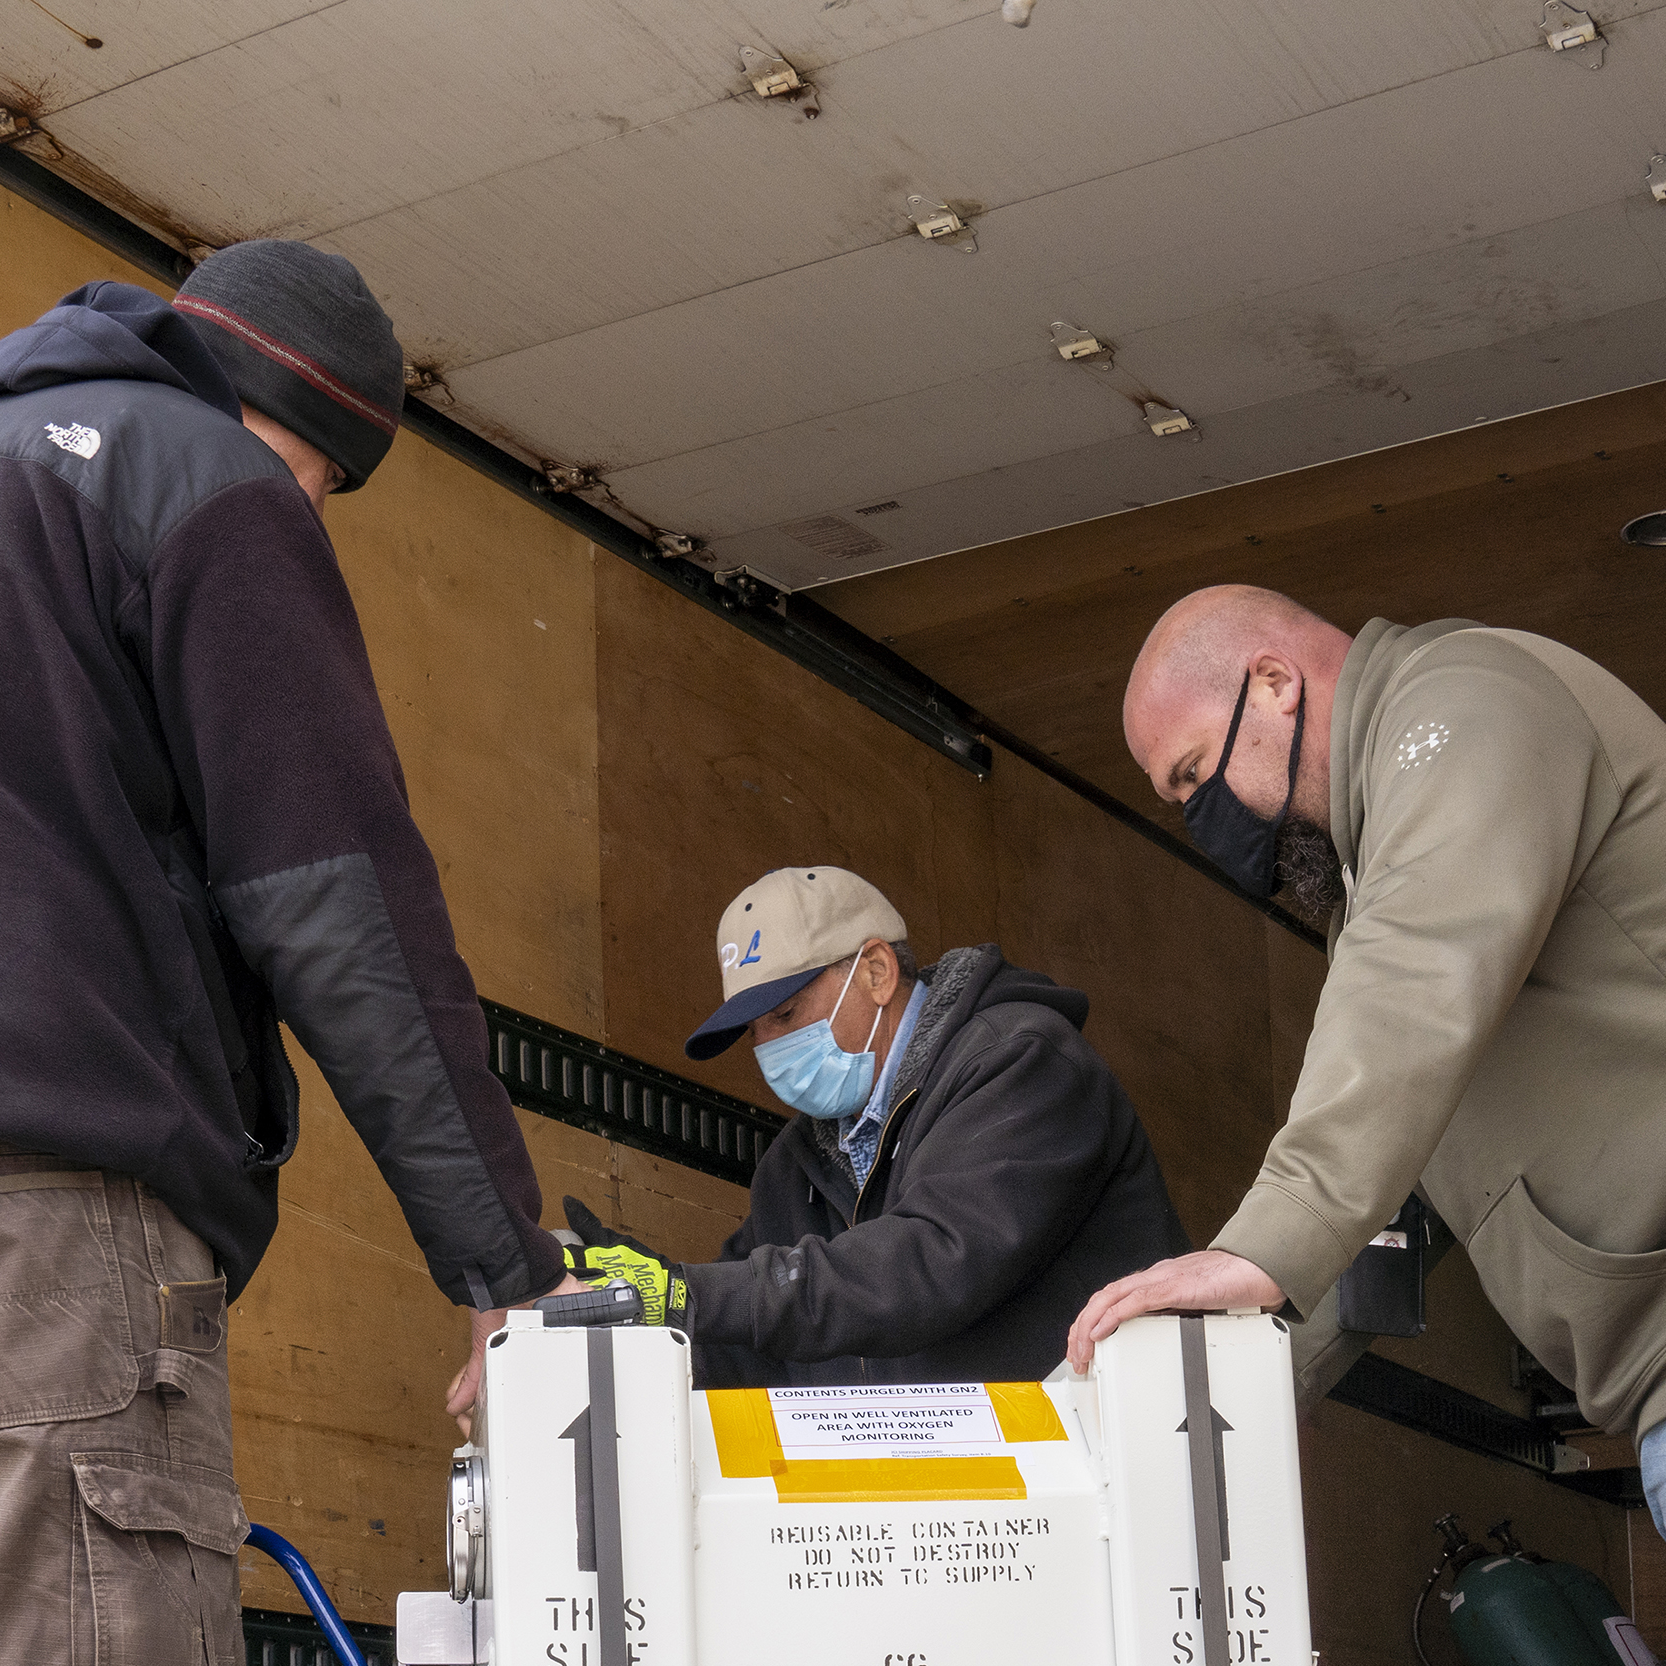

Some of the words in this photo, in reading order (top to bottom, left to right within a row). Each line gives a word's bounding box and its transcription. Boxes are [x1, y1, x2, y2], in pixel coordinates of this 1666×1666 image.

[44, 422, 84, 444] NORTH
[69, 422, 92, 436] THE
[47, 433, 81, 452] FACE
[630, 1263, 665, 1326] Mechan
[774, 1388, 847, 1398] CONTENTS
[850, 1387, 906, 1397] PURGED
[910, 1386, 946, 1395] WITH
[949, 1385, 979, 1394] GN2
[791, 1412, 829, 1421] OPEN
[833, 1411, 848, 1420] IN
[850, 1410, 889, 1419] WELL
[891, 1408, 973, 1418] VENTILATED
[816, 1422, 853, 1431] AREA
[856, 1421, 895, 1430] WITH
[898, 1420, 954, 1429] OXYGEN
[841, 1432, 935, 1442] MONITORING
[771, 1523, 893, 1544] REUSABLE
[912, 1518, 1050, 1539] CONTAINER
[805, 1549, 832, 1566] DO
[851, 1546, 896, 1564] NOT
[913, 1542, 1020, 1562] DESTROY
[789, 1571, 884, 1590] RETURN
[900, 1568, 929, 1585] TO
[945, 1564, 1036, 1584] SUPPLY
[545, 1597, 645, 1631] THS
[1172, 1630, 1271, 1664] SDE
